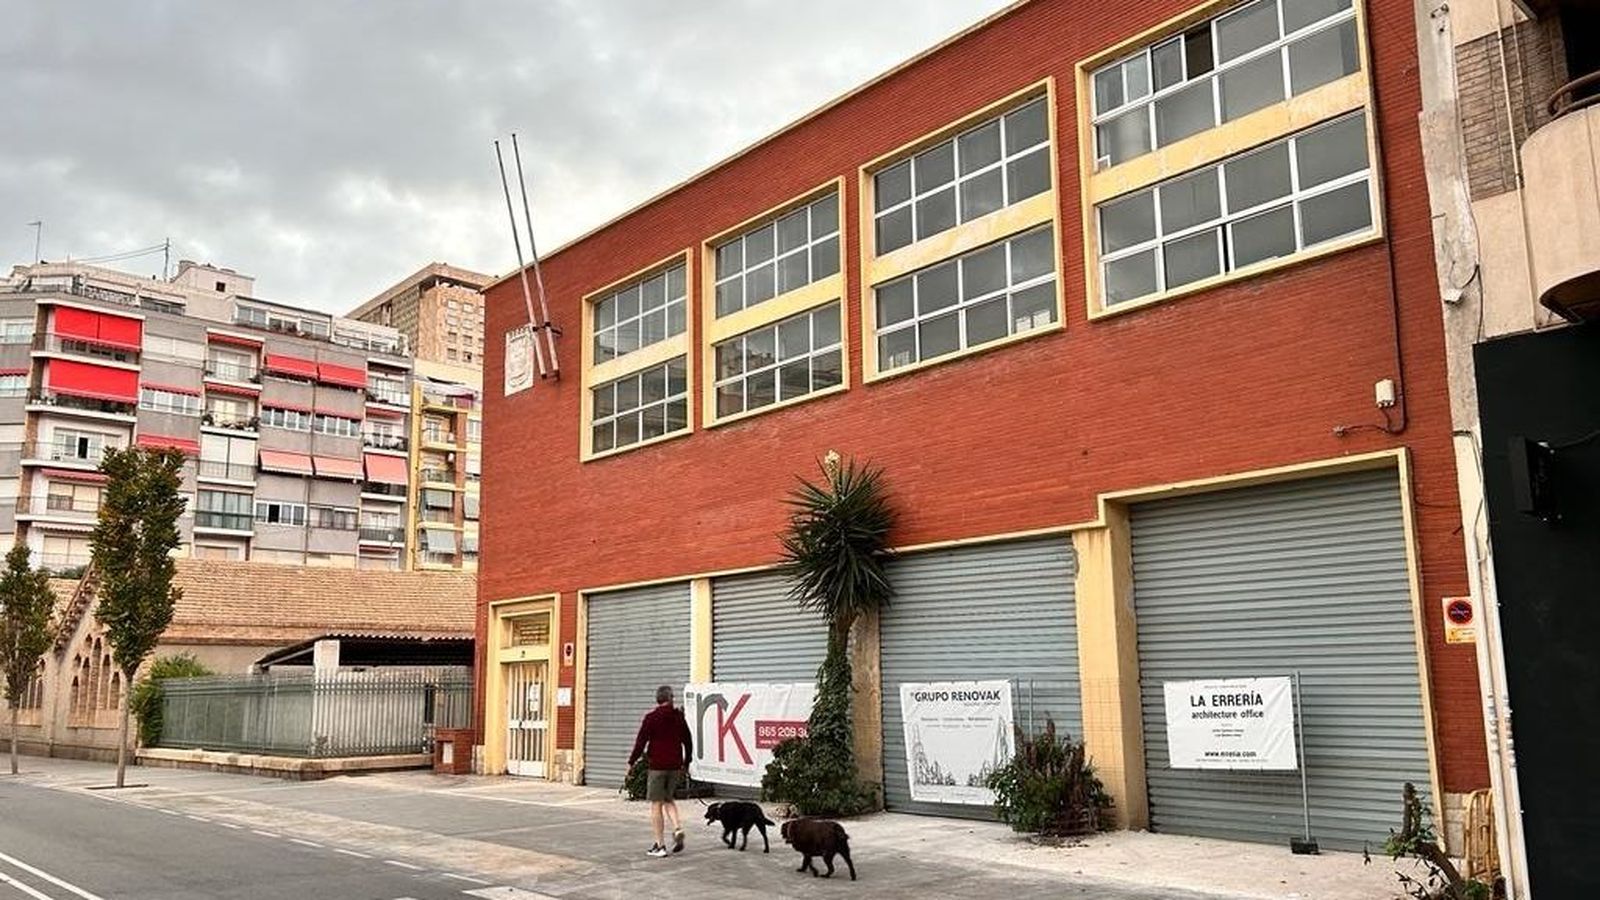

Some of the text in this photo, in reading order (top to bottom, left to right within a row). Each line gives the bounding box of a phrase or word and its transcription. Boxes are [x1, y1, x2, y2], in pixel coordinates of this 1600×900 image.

[914, 691, 949, 702] GRUPO
[951, 690, 1001, 701] RENOVAK
[1190, 690, 1264, 707] LA ERRERÍA
[1191, 709, 1264, 719] architecture office
